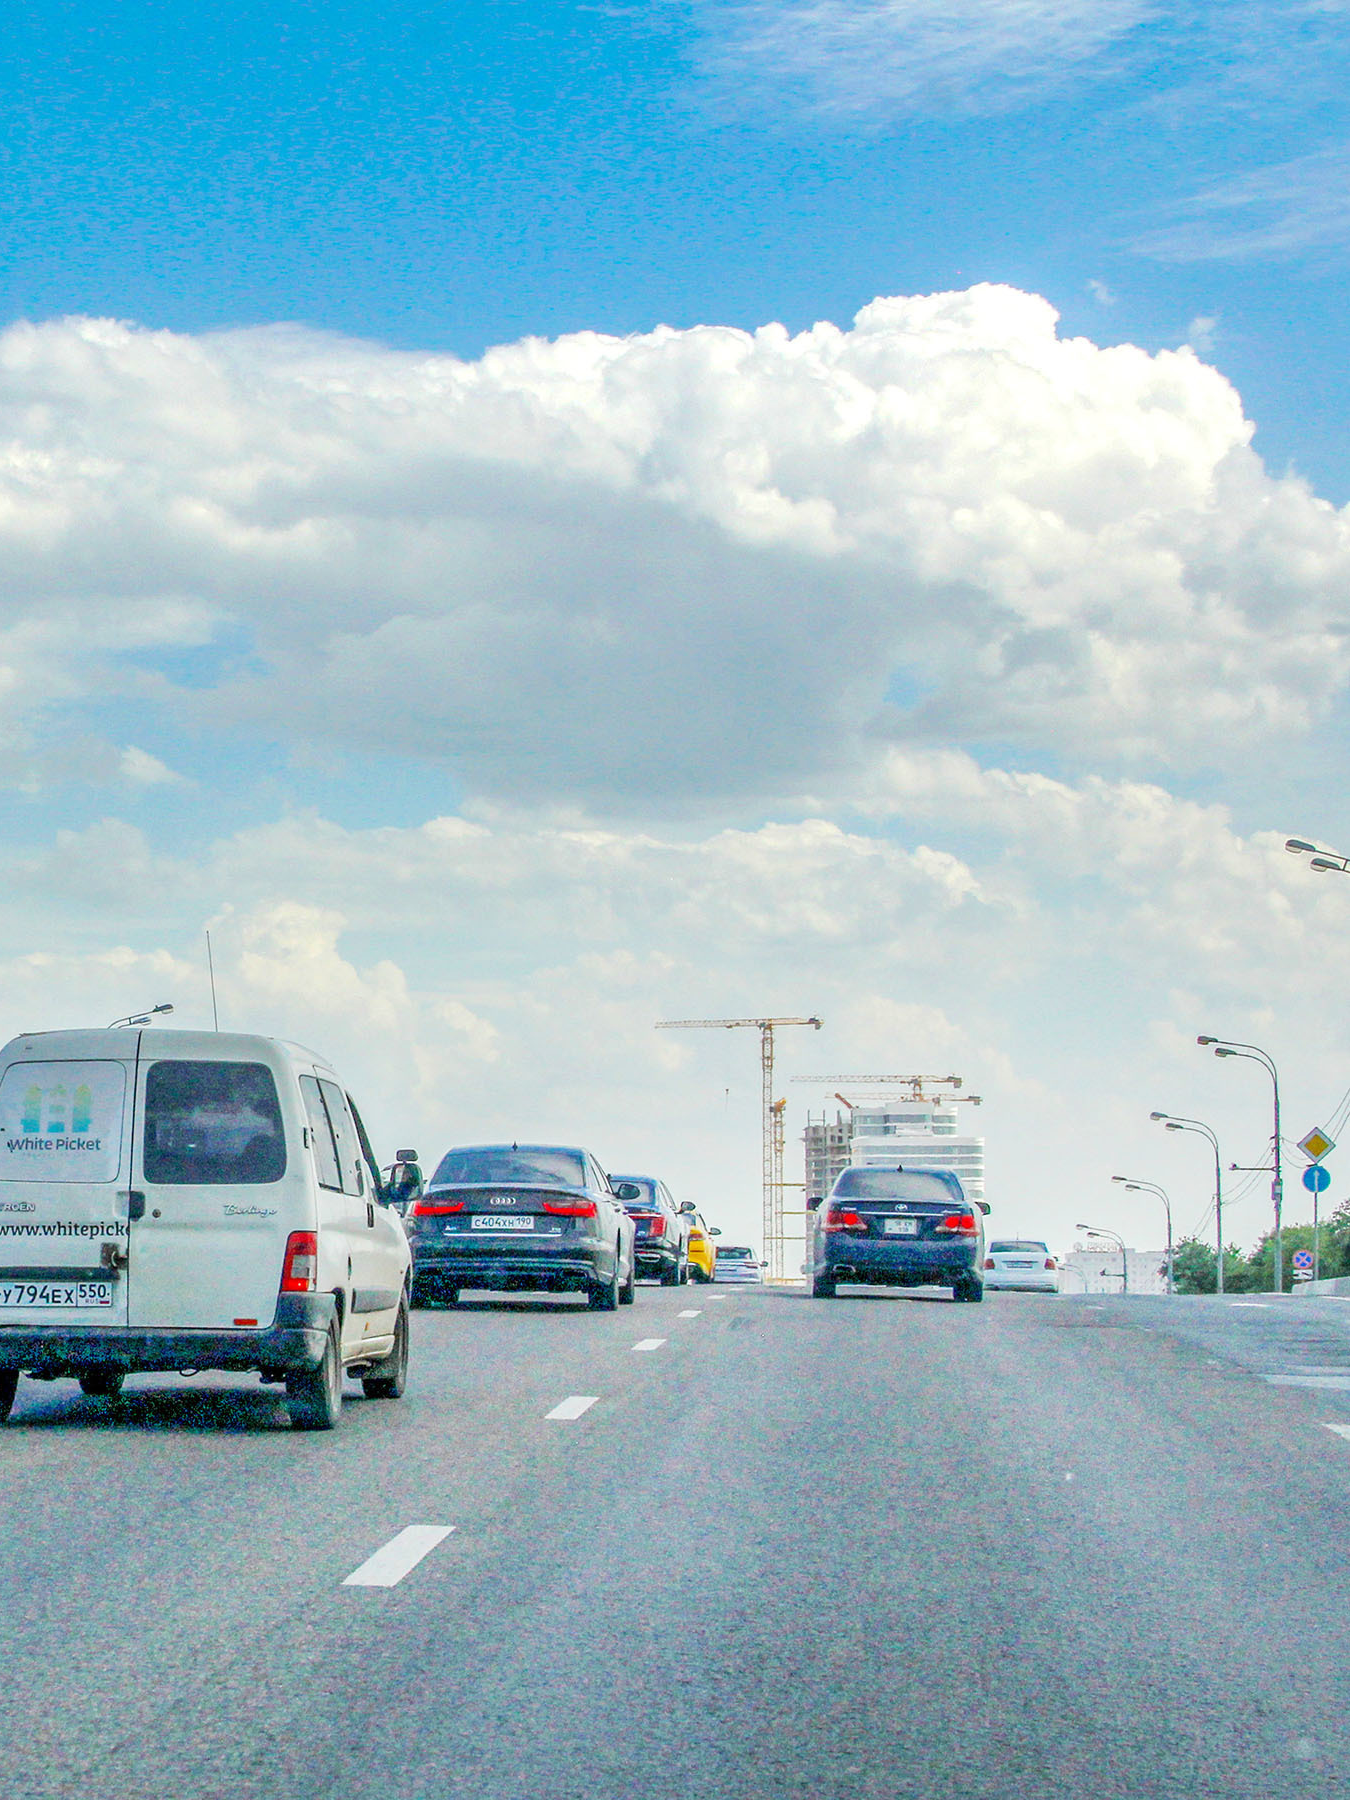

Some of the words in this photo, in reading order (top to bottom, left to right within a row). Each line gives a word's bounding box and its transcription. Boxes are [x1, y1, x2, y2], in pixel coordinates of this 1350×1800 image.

[10, 1137, 53, 1151] White
[56, 1137, 101, 1151] Picket
[79, 1284, 106, 1298] 550
